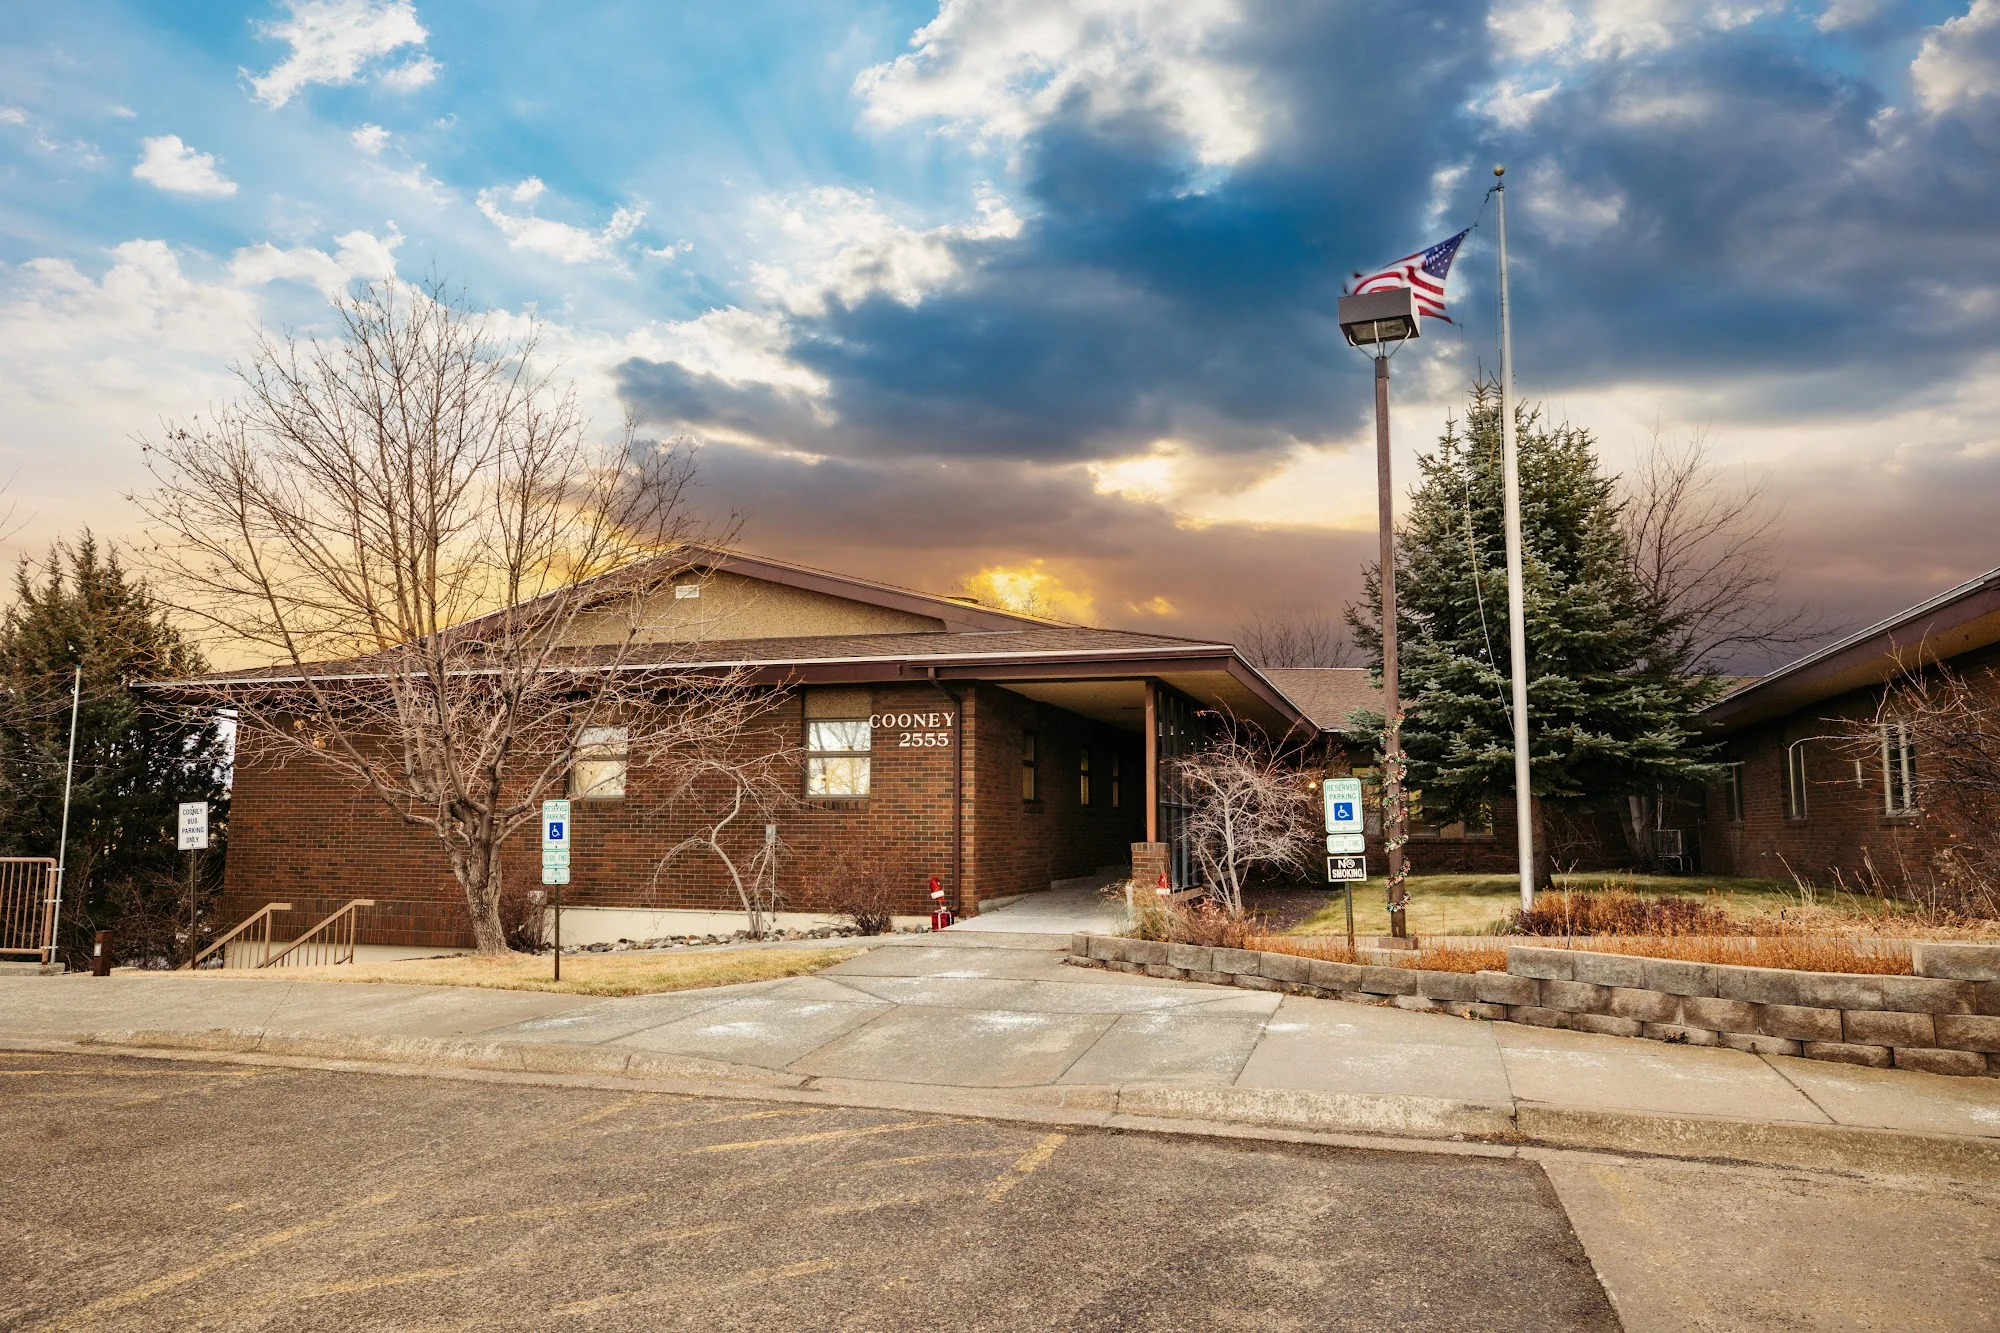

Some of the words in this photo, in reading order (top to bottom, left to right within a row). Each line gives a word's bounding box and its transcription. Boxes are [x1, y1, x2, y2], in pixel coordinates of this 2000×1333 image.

[869, 712, 955, 728] COONEY
[899, 732, 949, 747] 2555
[1329, 792, 1357, 800] PARKING
[1337, 859, 1356, 869] NO
[1332, 868, 1363, 879] SMOKING
